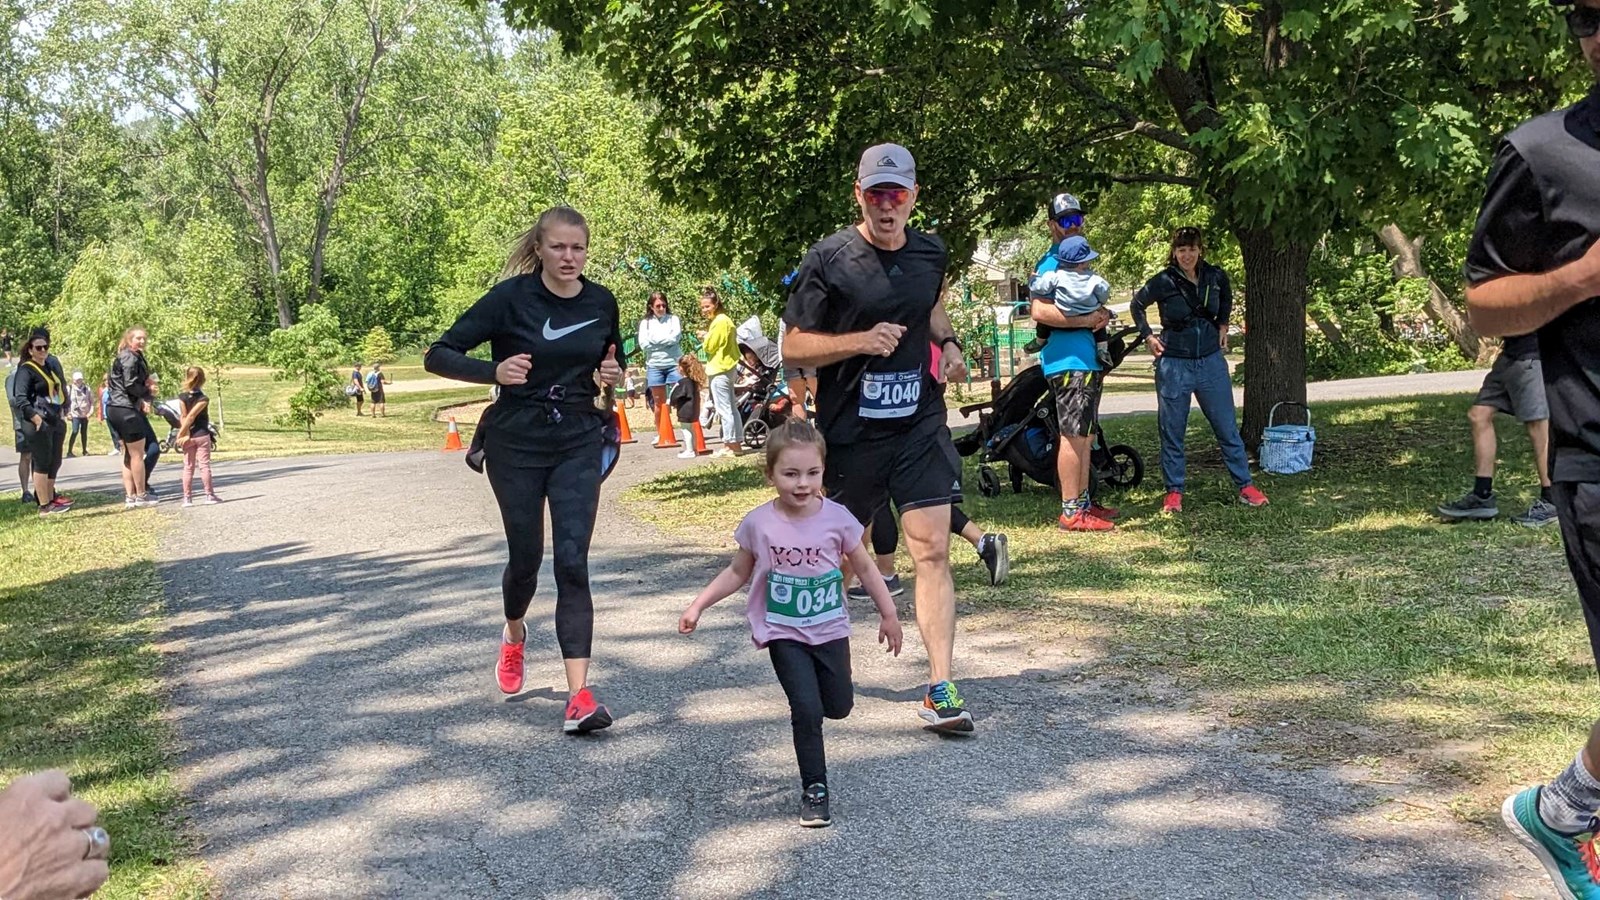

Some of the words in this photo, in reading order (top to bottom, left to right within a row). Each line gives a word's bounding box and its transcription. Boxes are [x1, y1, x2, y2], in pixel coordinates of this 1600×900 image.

[881, 381, 920, 405] 1040
[770, 546, 821, 566] YOU
[797, 582, 839, 615] 034
